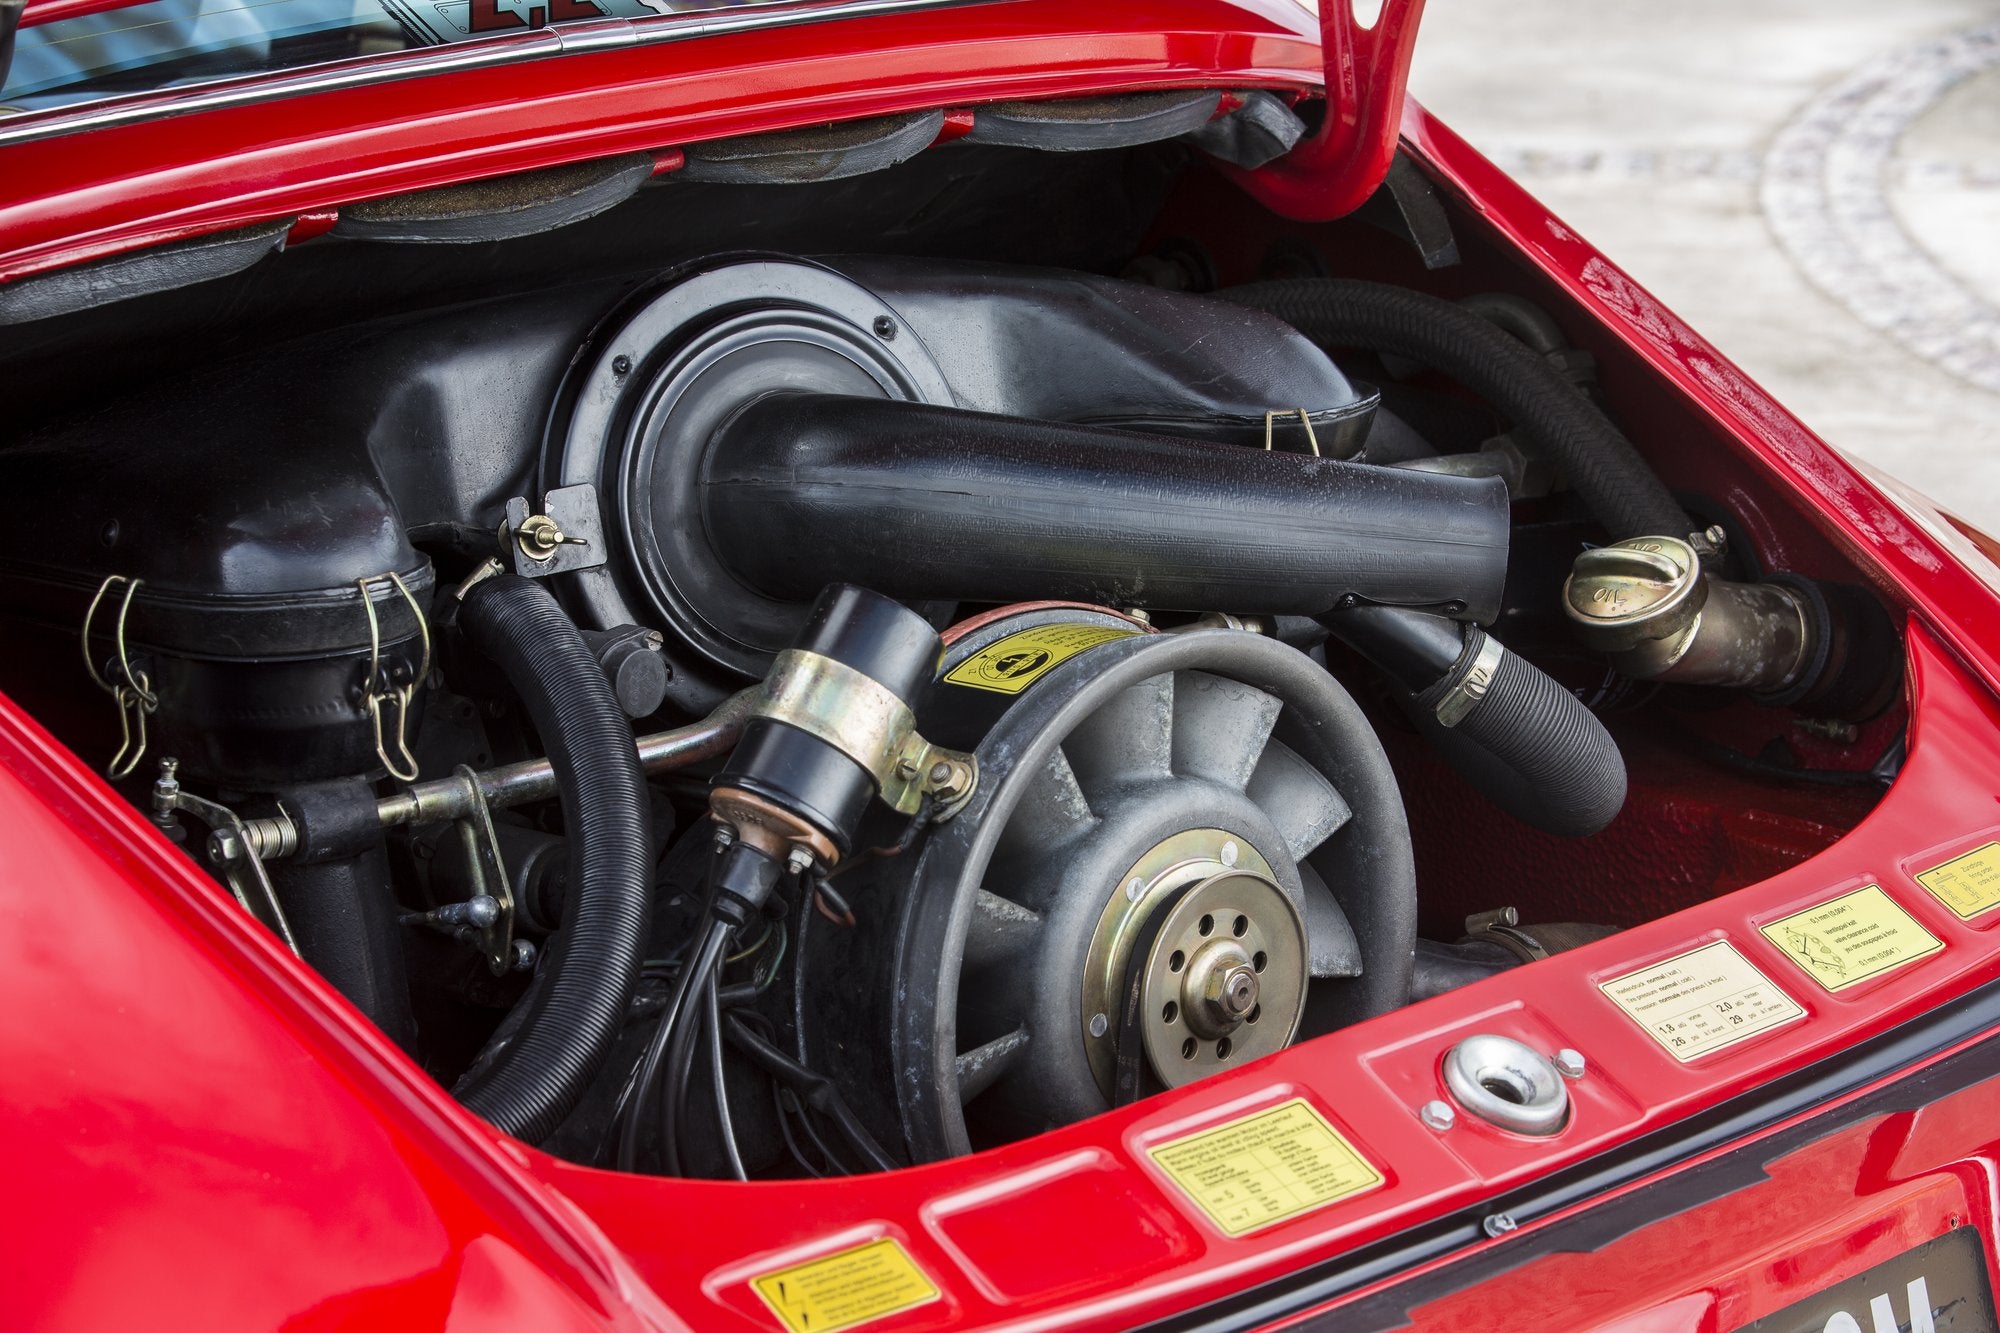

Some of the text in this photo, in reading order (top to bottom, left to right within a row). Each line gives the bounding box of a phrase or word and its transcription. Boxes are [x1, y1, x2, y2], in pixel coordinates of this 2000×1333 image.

[1593, 586, 1627, 604] OIL
[1824, 923, 1848, 935] Ventilspiel
[1846, 928, 1869, 939] clearance
[1861, 935, 1883, 946] soupapes
[1885, 928, 1898, 936] froid
[1616, 982, 1645, 994] Reifendruck
[1646, 974, 1666, 984] normal
[1636, 990, 1658, 1000] pressure
[1659, 981, 1678, 991] normal
[1635, 1002, 1657, 1012] Pression
[1658, 993, 1681, 1003] normale
[1716, 1002, 1732, 1012] 2,0
[1729, 1015, 1743, 1024] 29
[1659, 1024, 1675, 1034] 1,8
[1671, 1037, 1686, 1046] 26
